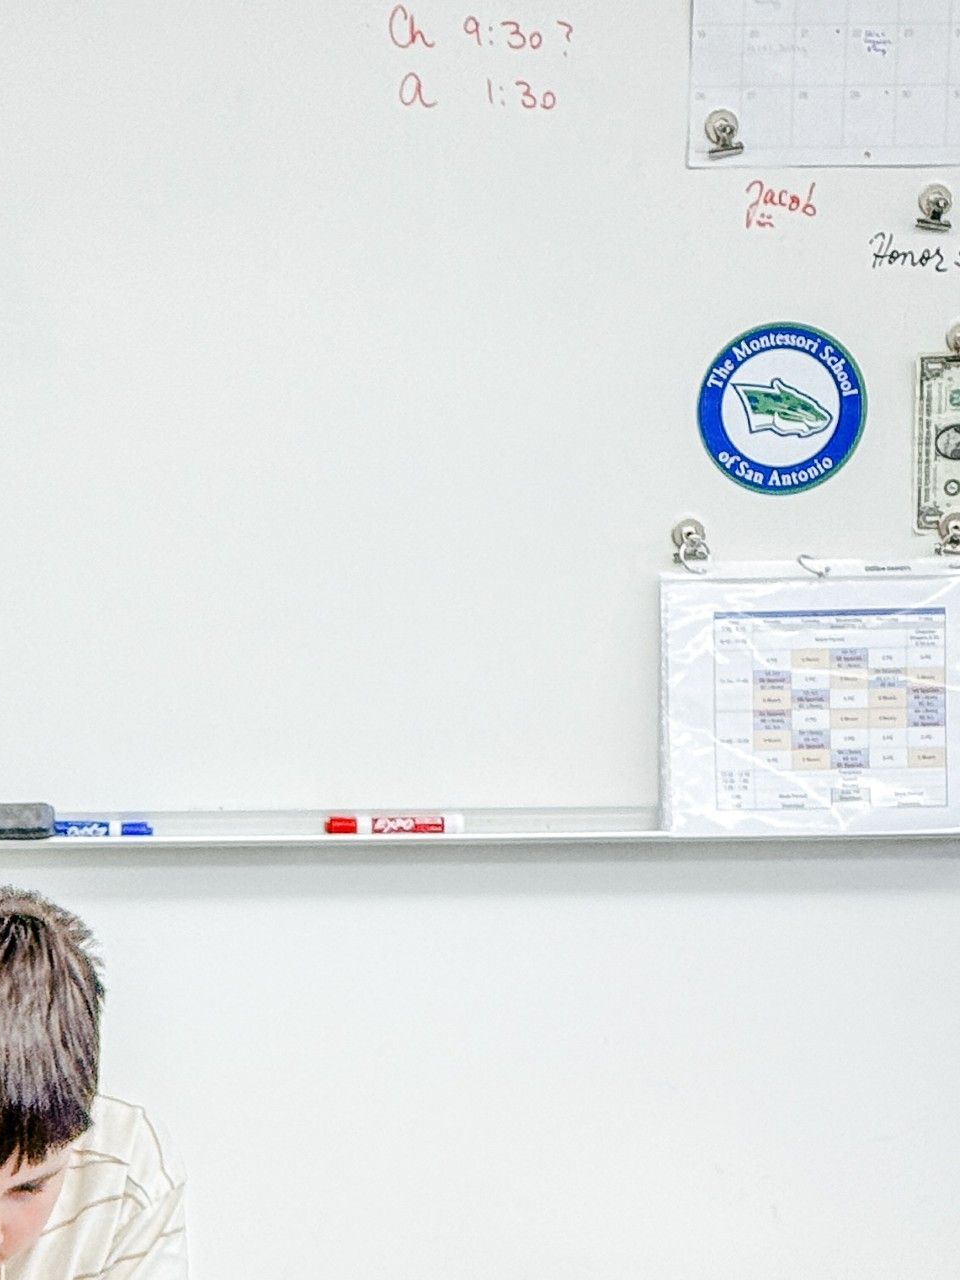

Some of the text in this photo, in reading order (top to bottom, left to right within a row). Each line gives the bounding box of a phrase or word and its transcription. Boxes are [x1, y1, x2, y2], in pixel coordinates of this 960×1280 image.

[462, 15, 544, 50] 9:30
[486, 78, 557, 110] 1:30
[745, 180, 817, 229] Jacob
[868, 231, 949, 273] Honor
[706, 332, 859, 397] The Montessori School
[718, 451, 834, 487] of San Antonio
